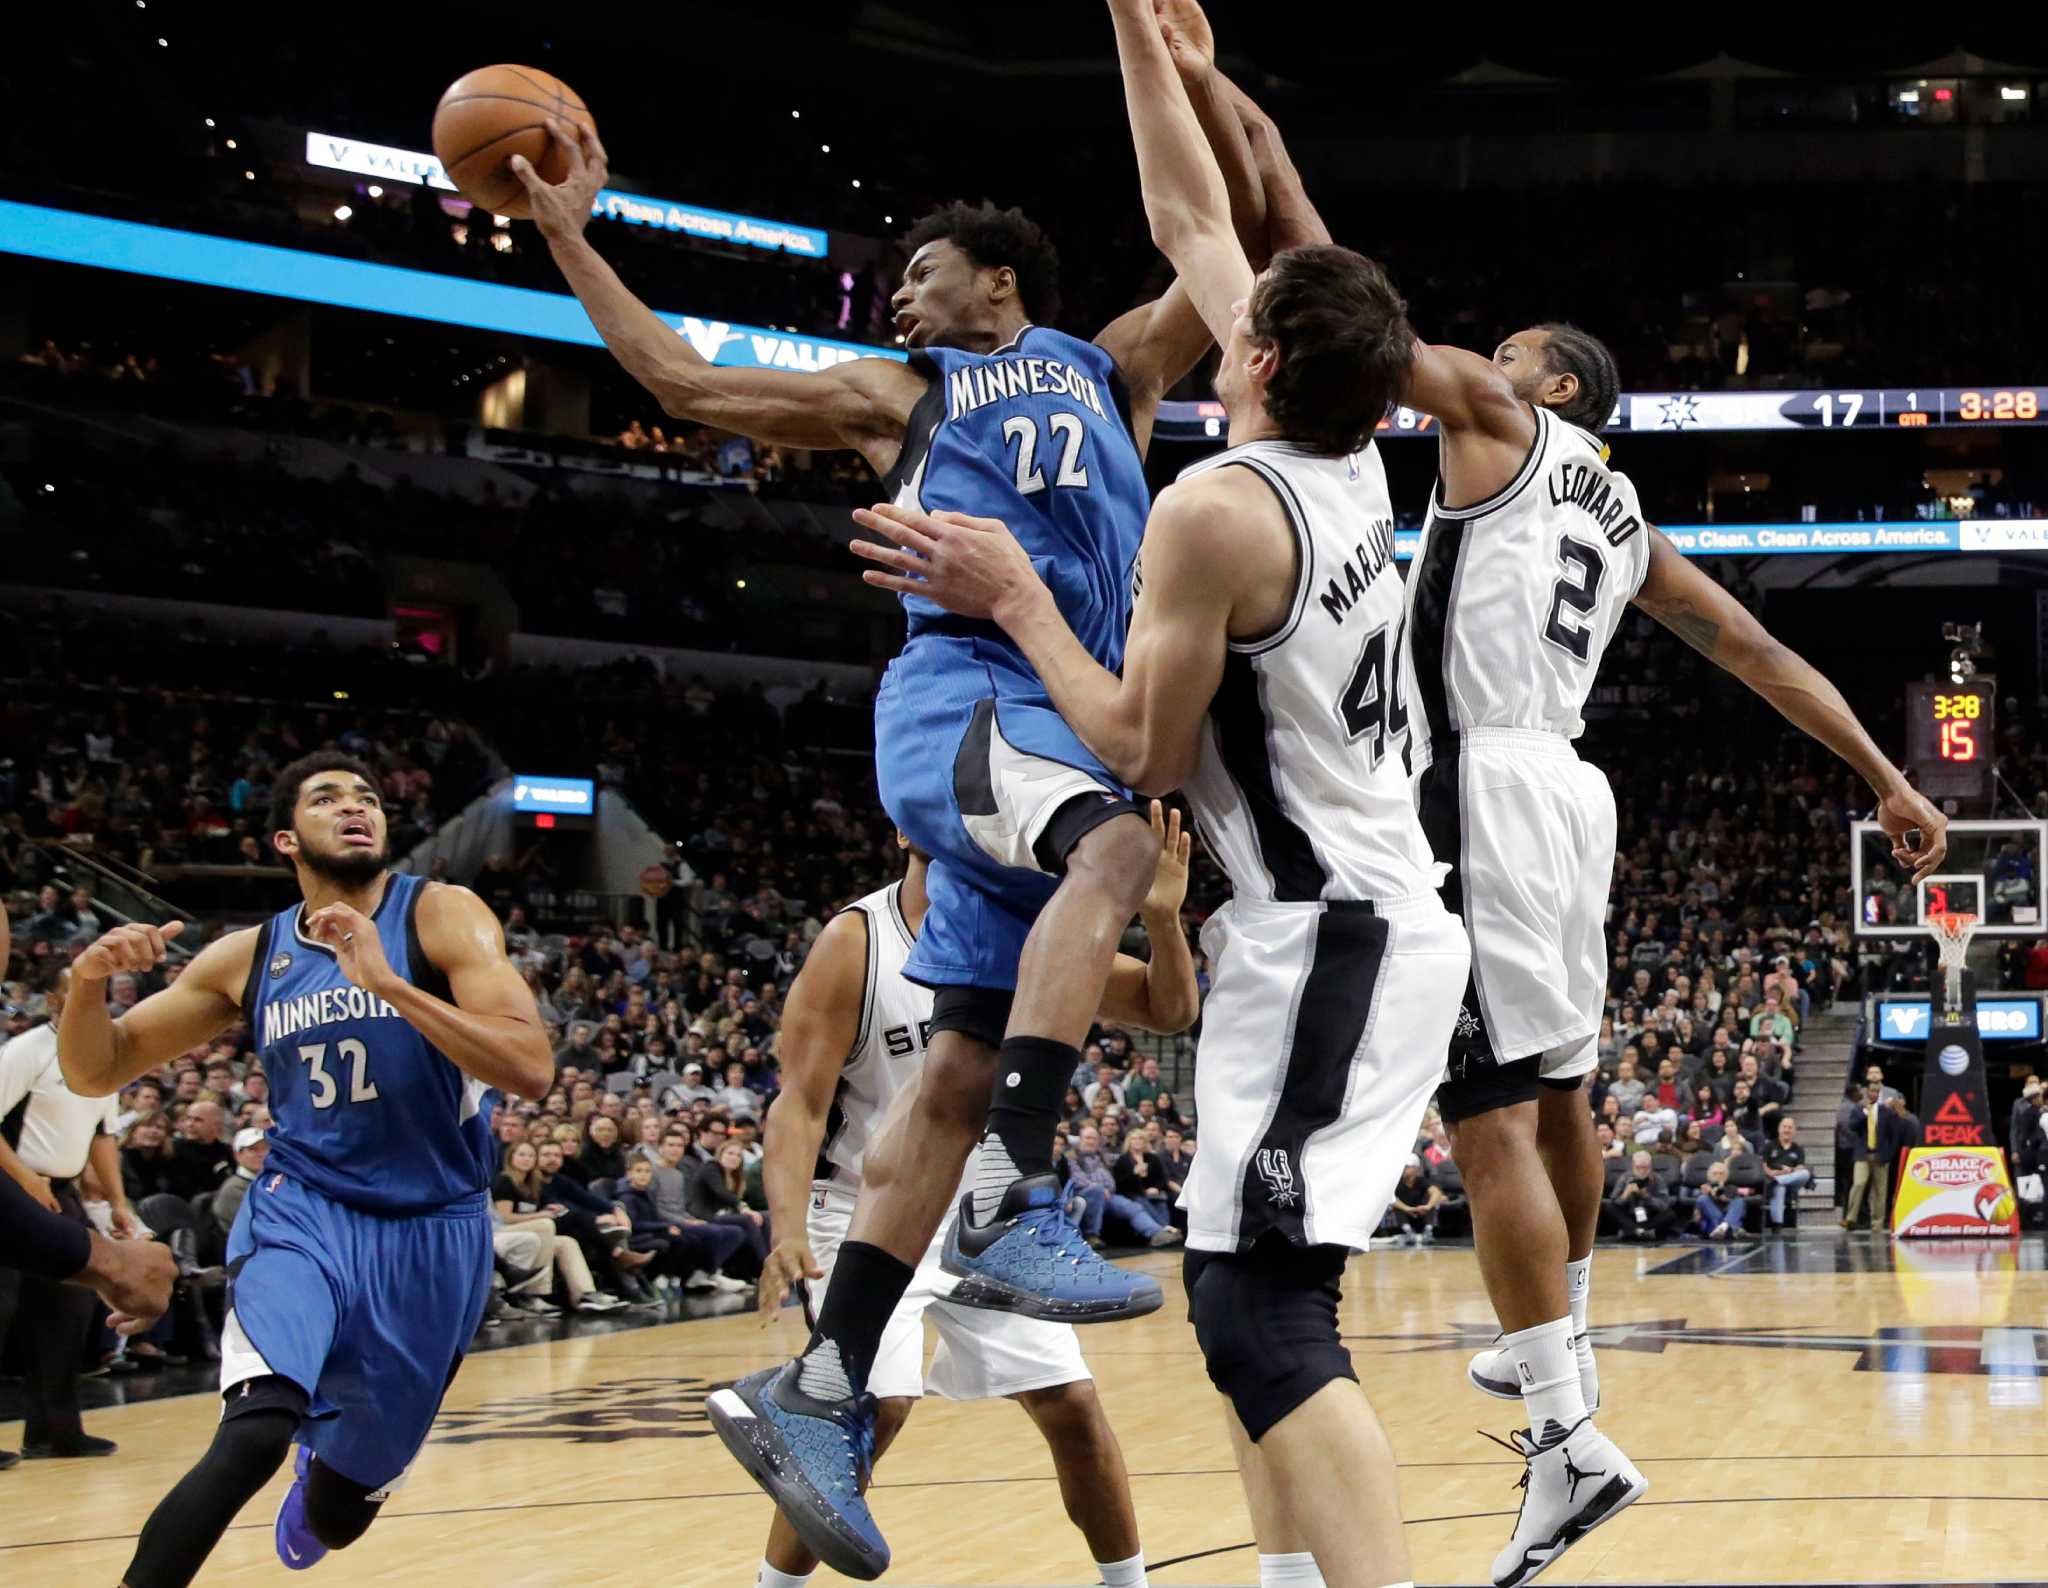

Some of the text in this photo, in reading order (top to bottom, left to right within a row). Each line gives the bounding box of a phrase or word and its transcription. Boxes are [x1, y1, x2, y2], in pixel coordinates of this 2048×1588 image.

[608, 196, 664, 224] Clean
[667, 208, 733, 237] Across
[735, 221, 816, 252] America.
[751, 335, 882, 372] VALE
[949, 358, 1113, 423] MINNESOTA
[1812, 392, 2038, 427] 17 1 3:28
[1899, 412, 1928, 426] QTR
[1002, 412, 1090, 496] 22
[1548, 463, 1640, 548] LEONARD
[1699, 529, 1751, 548] Clean.
[1757, 529, 1807, 546] Clean
[1814, 529, 1871, 546] Across
[1874, 527, 1950, 545] America.
[1541, 531, 1609, 666] 2
[1934, 695, 1980, 719] 3:28
[1941, 721, 1974, 760] 15
[298, 1037, 380, 1110] 32
[1924, 1124, 1985, 1145] PEAK
[1929, 1170, 1979, 1183] CHECK
[1930, 1157, 1981, 1170] BRAKE
